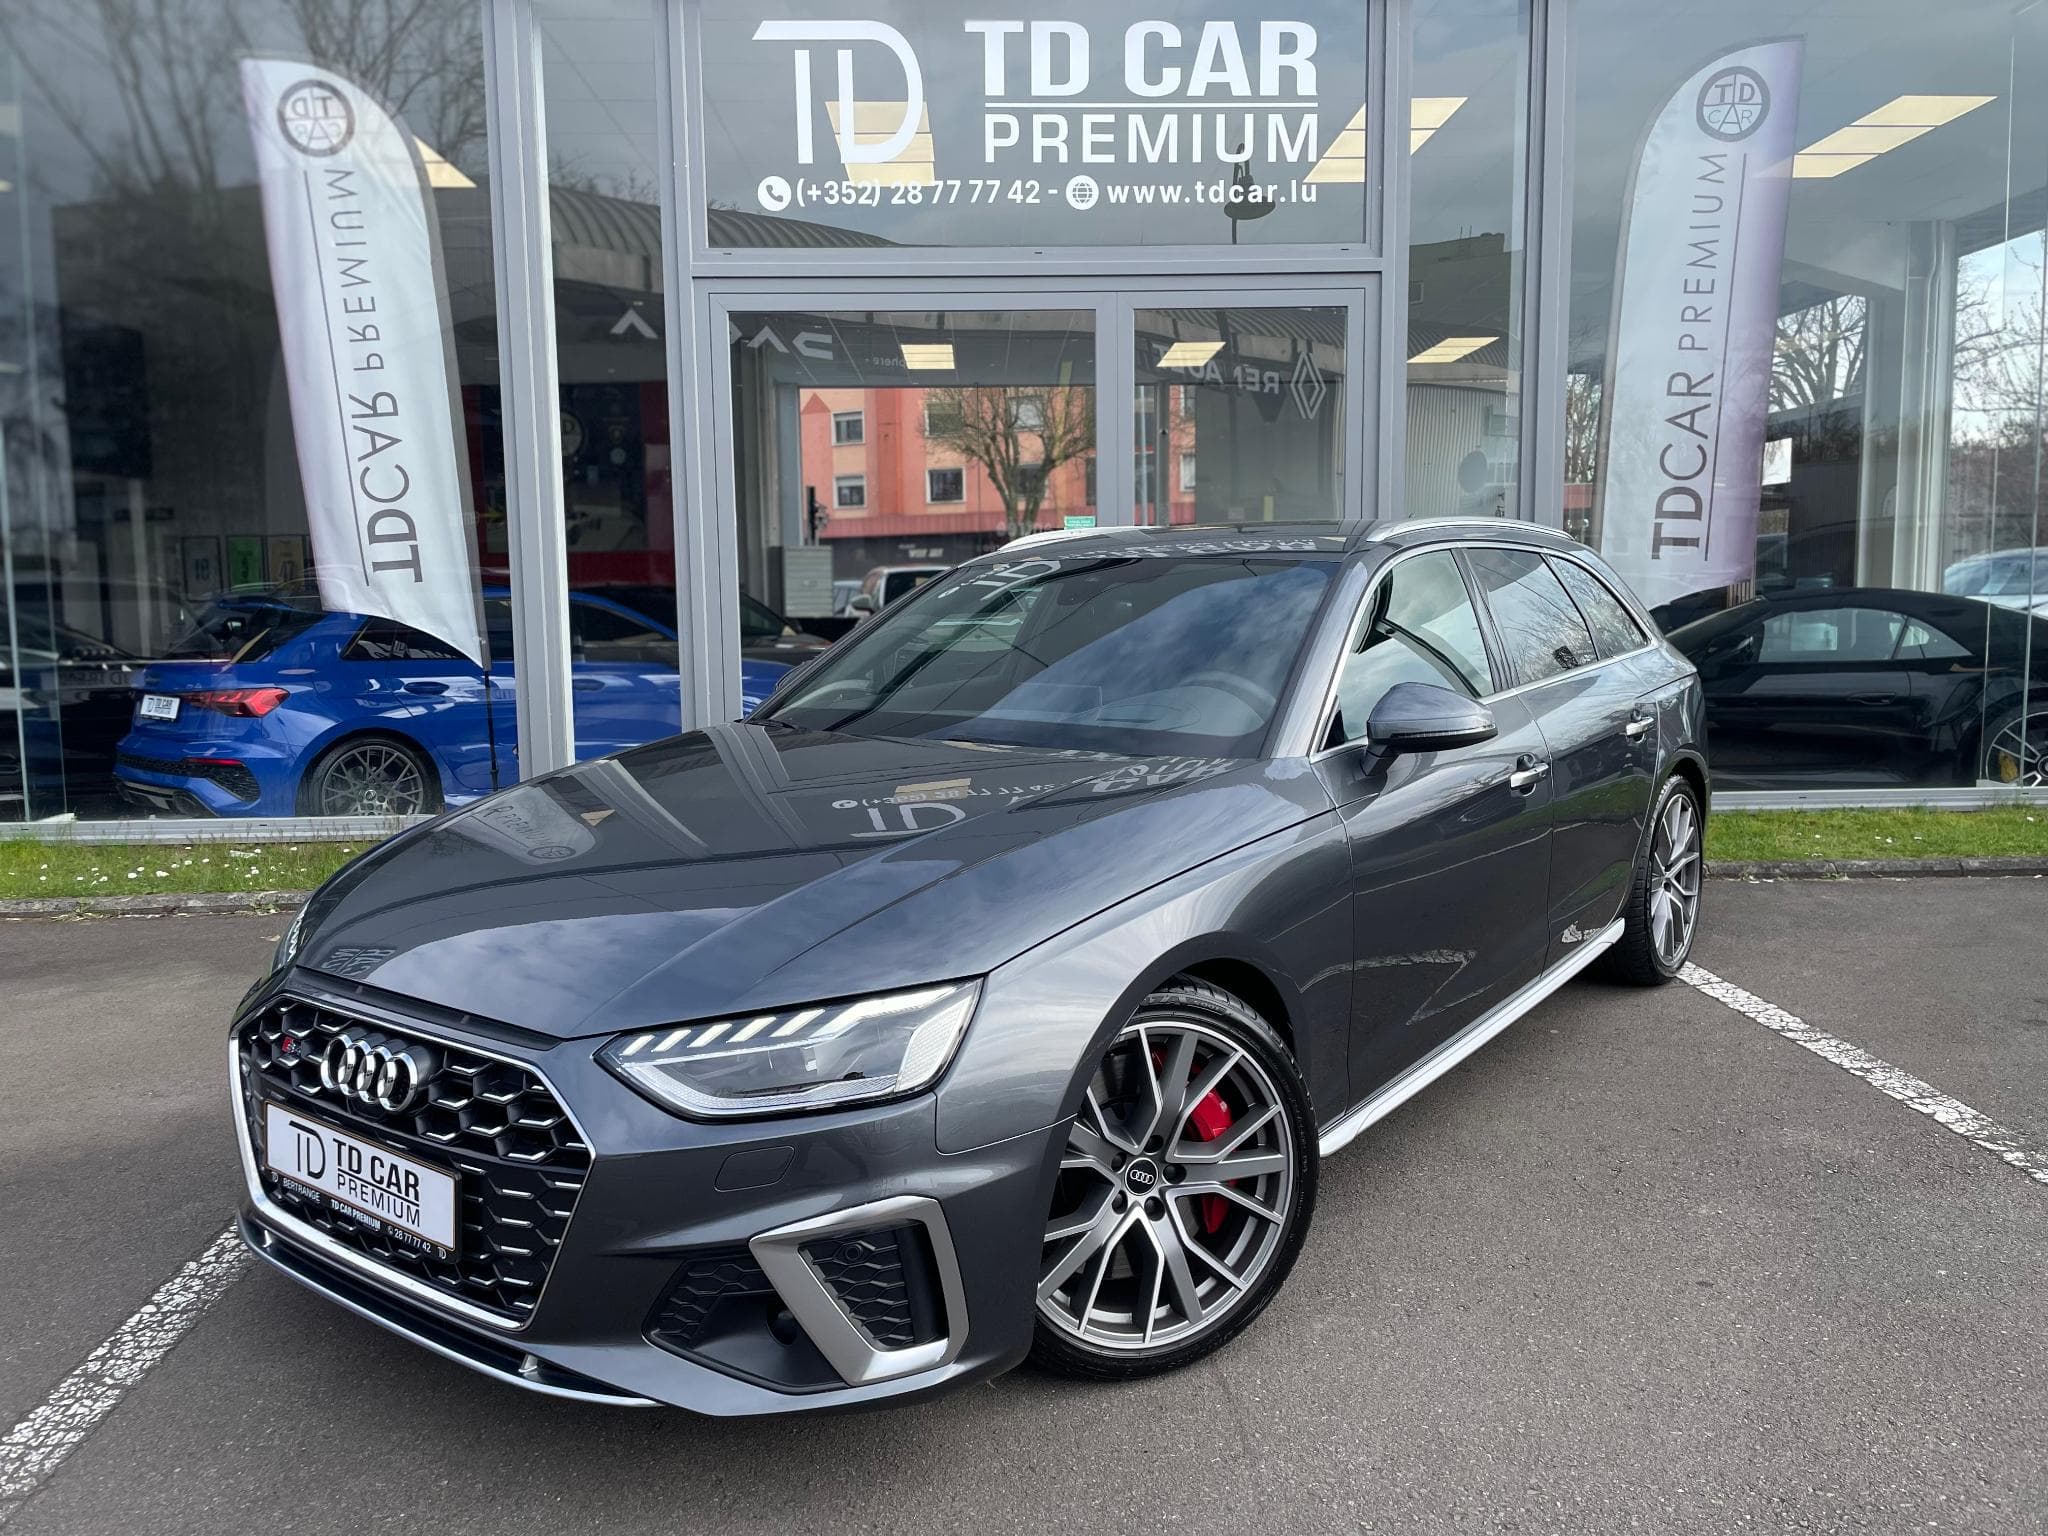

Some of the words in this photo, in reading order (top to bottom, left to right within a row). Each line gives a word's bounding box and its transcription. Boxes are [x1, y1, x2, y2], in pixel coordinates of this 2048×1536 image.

[964, 20, 1090, 97] TD
[1124, 20, 1318, 98] CAR
[1714, 82, 1756, 103] TD
[985, 113, 1318, 164] PREMIUM
[796, 178, 881, 207] (+352)
[890, 181, 923, 204] 28
[931, 180, 961, 204] 77
[968, 180, 1001, 204] 77
[1007, 180, 1041, 204] 42
[1106, 179, 1318, 204] www.tdcar.lu
[1678, 153, 1728, 351] PREMIUM
[283, 1177, 321, 1204] BERTRANGE
[333, 1138, 362, 1175] TD
[370, 1155, 420, 1203] CAR
[331, 1199, 341, 1211] TD
[340, 1203, 354, 1218] CAR
[352, 1208, 381, 1232] PREMIUM
[394, 1228, 403, 1241] 28
[422, 1241, 432, 1254] 42
[337, 1172, 421, 1228] PREMIUM
